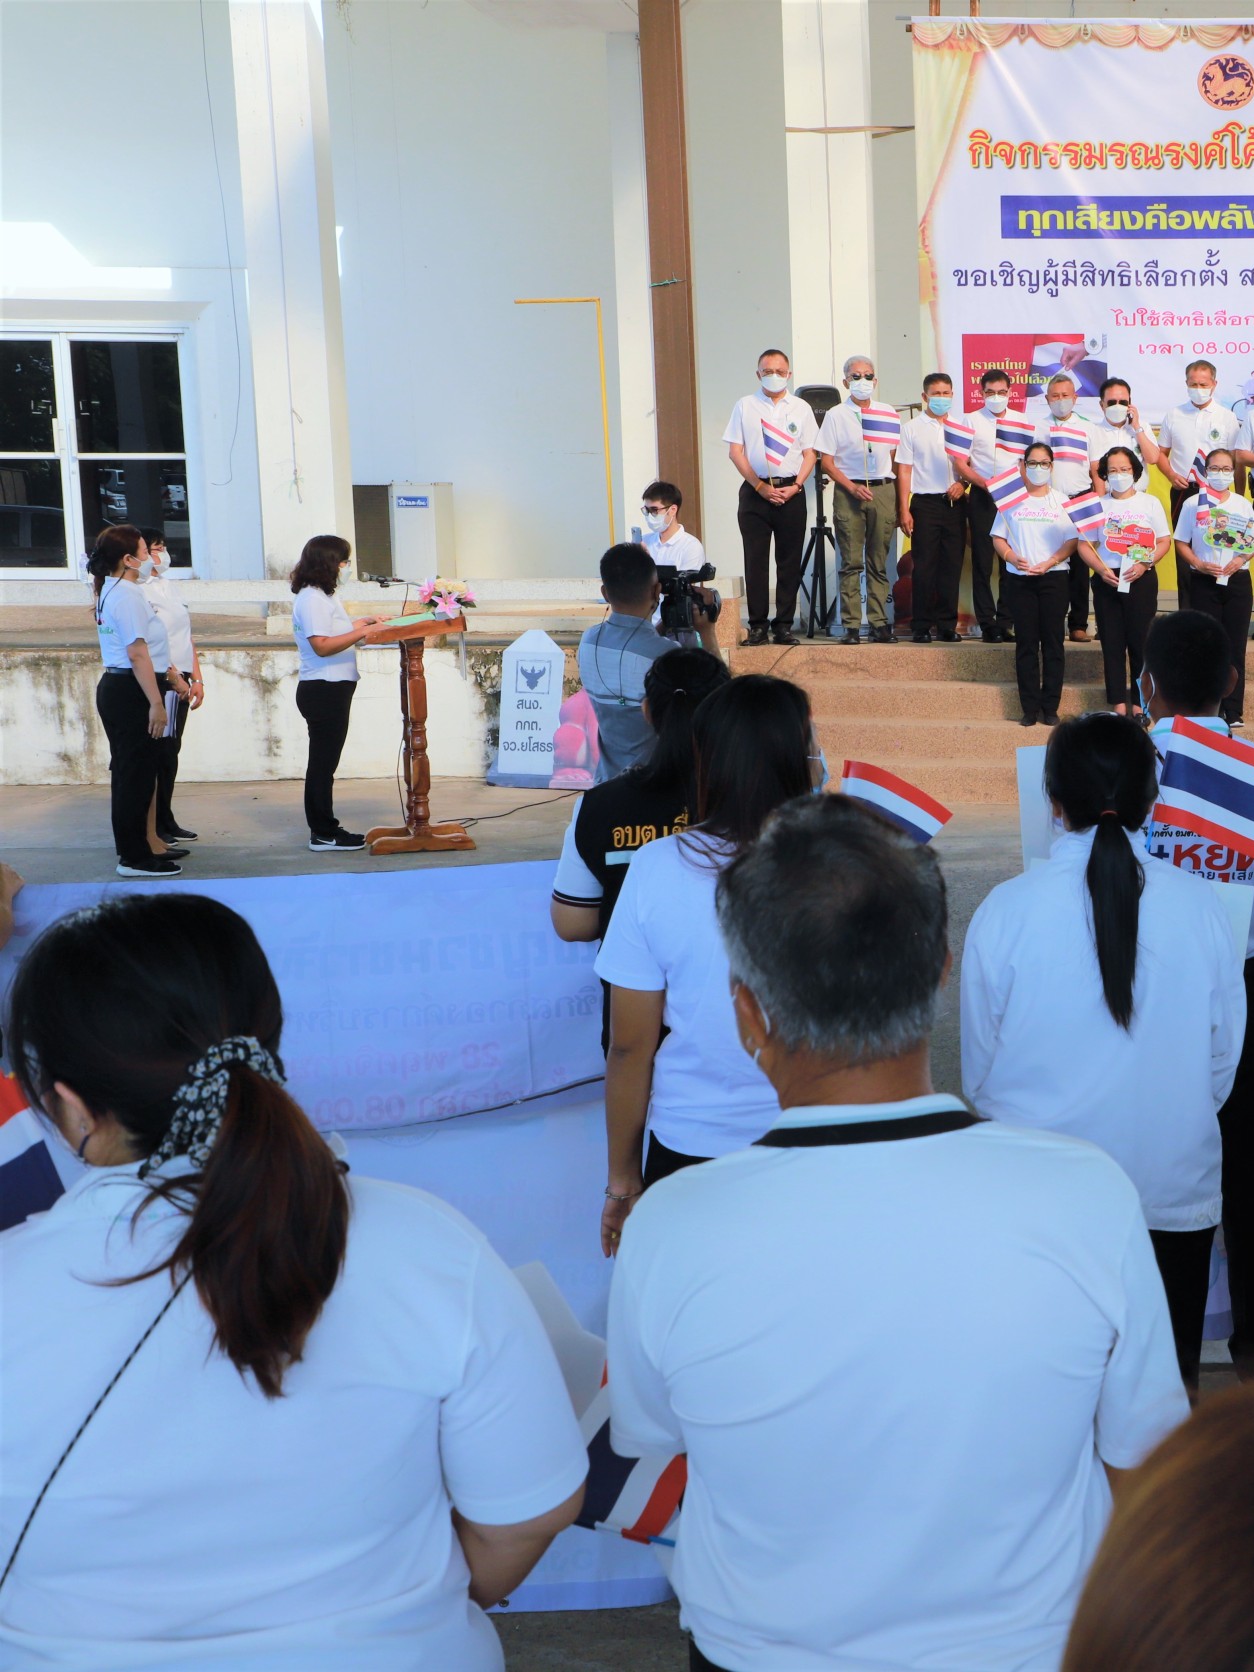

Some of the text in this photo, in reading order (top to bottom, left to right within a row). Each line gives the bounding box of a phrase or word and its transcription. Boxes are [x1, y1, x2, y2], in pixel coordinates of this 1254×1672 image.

[952, 249, 1228, 298] ขอเชิญผู้มีสิทธิเลือกตั้ง
[1138, 343, 1185, 355] เวลา
[970, 357, 1027, 370] เราคนไทย
[516, 698, 543, 710] สนง.
[515, 719, 542, 731] กกต.
[502, 735, 553, 753] จว.ยโสธร
